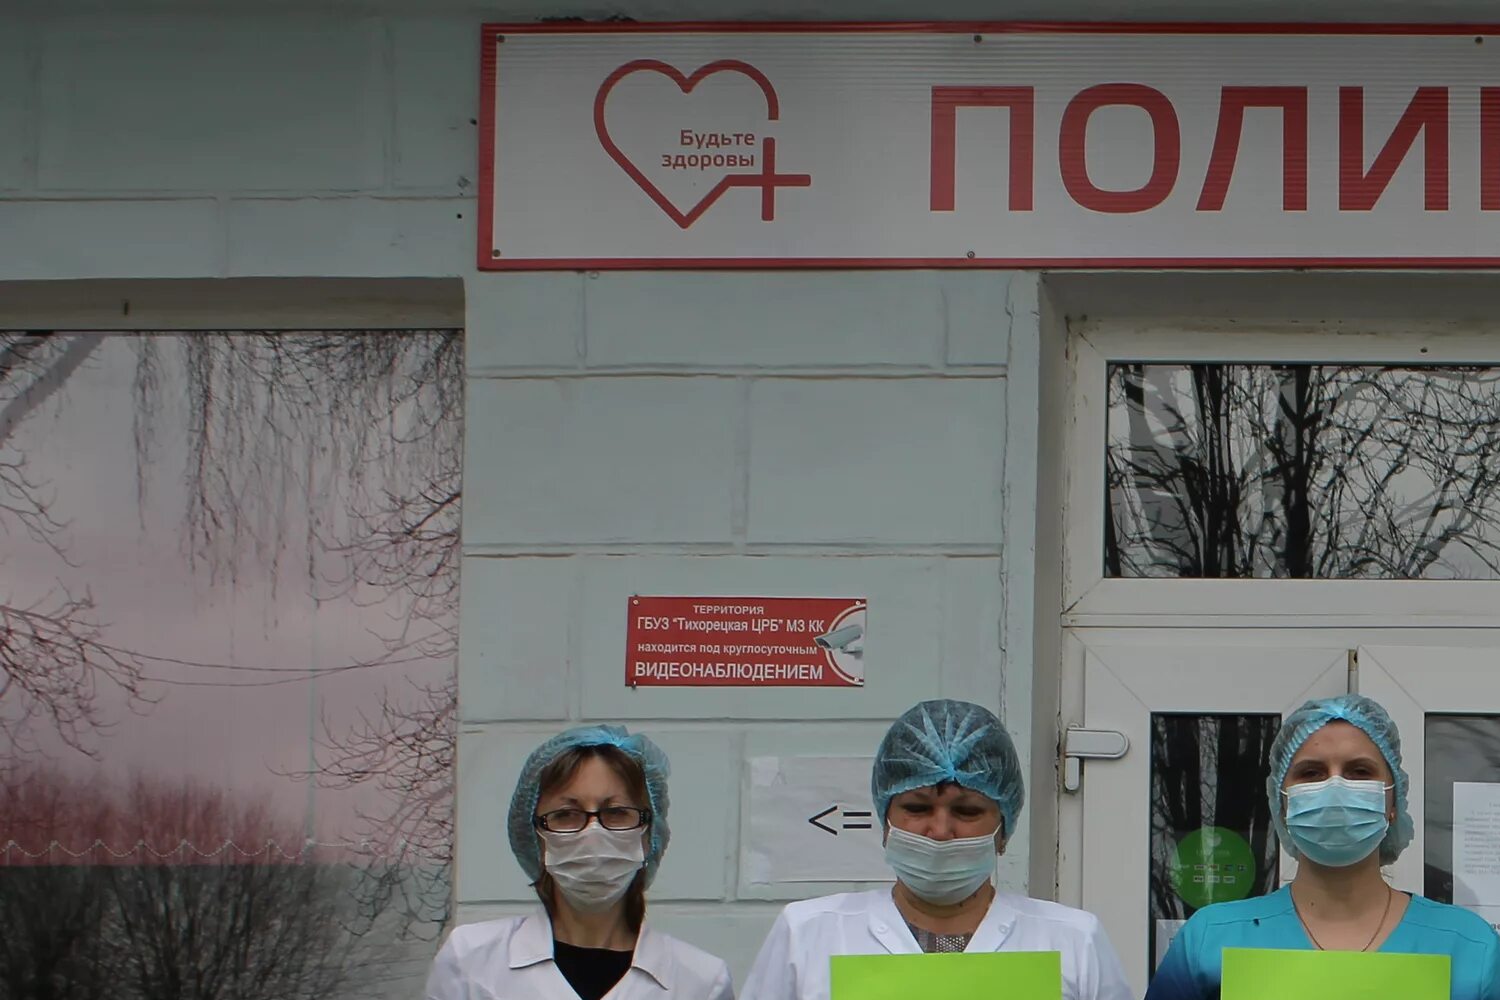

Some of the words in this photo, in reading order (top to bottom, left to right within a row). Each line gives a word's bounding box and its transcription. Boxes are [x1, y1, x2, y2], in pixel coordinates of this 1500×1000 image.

[680, 129, 755, 149] Будьте
[661, 153, 755, 171] здоровы
[693, 604, 764, 615] ТЕРРИТОРИЯ
[637, 616, 670, 630] ГБУЗ
[786, 619, 806, 633] МЗ
[808, 619, 825, 633] КК
[637, 643, 697, 654] находится
[699, 643, 721, 655] под
[723, 644, 818, 657] круглосуточным
[634, 661, 823, 681] ВИДЕОНАБЛЮДЕНИЕМ
